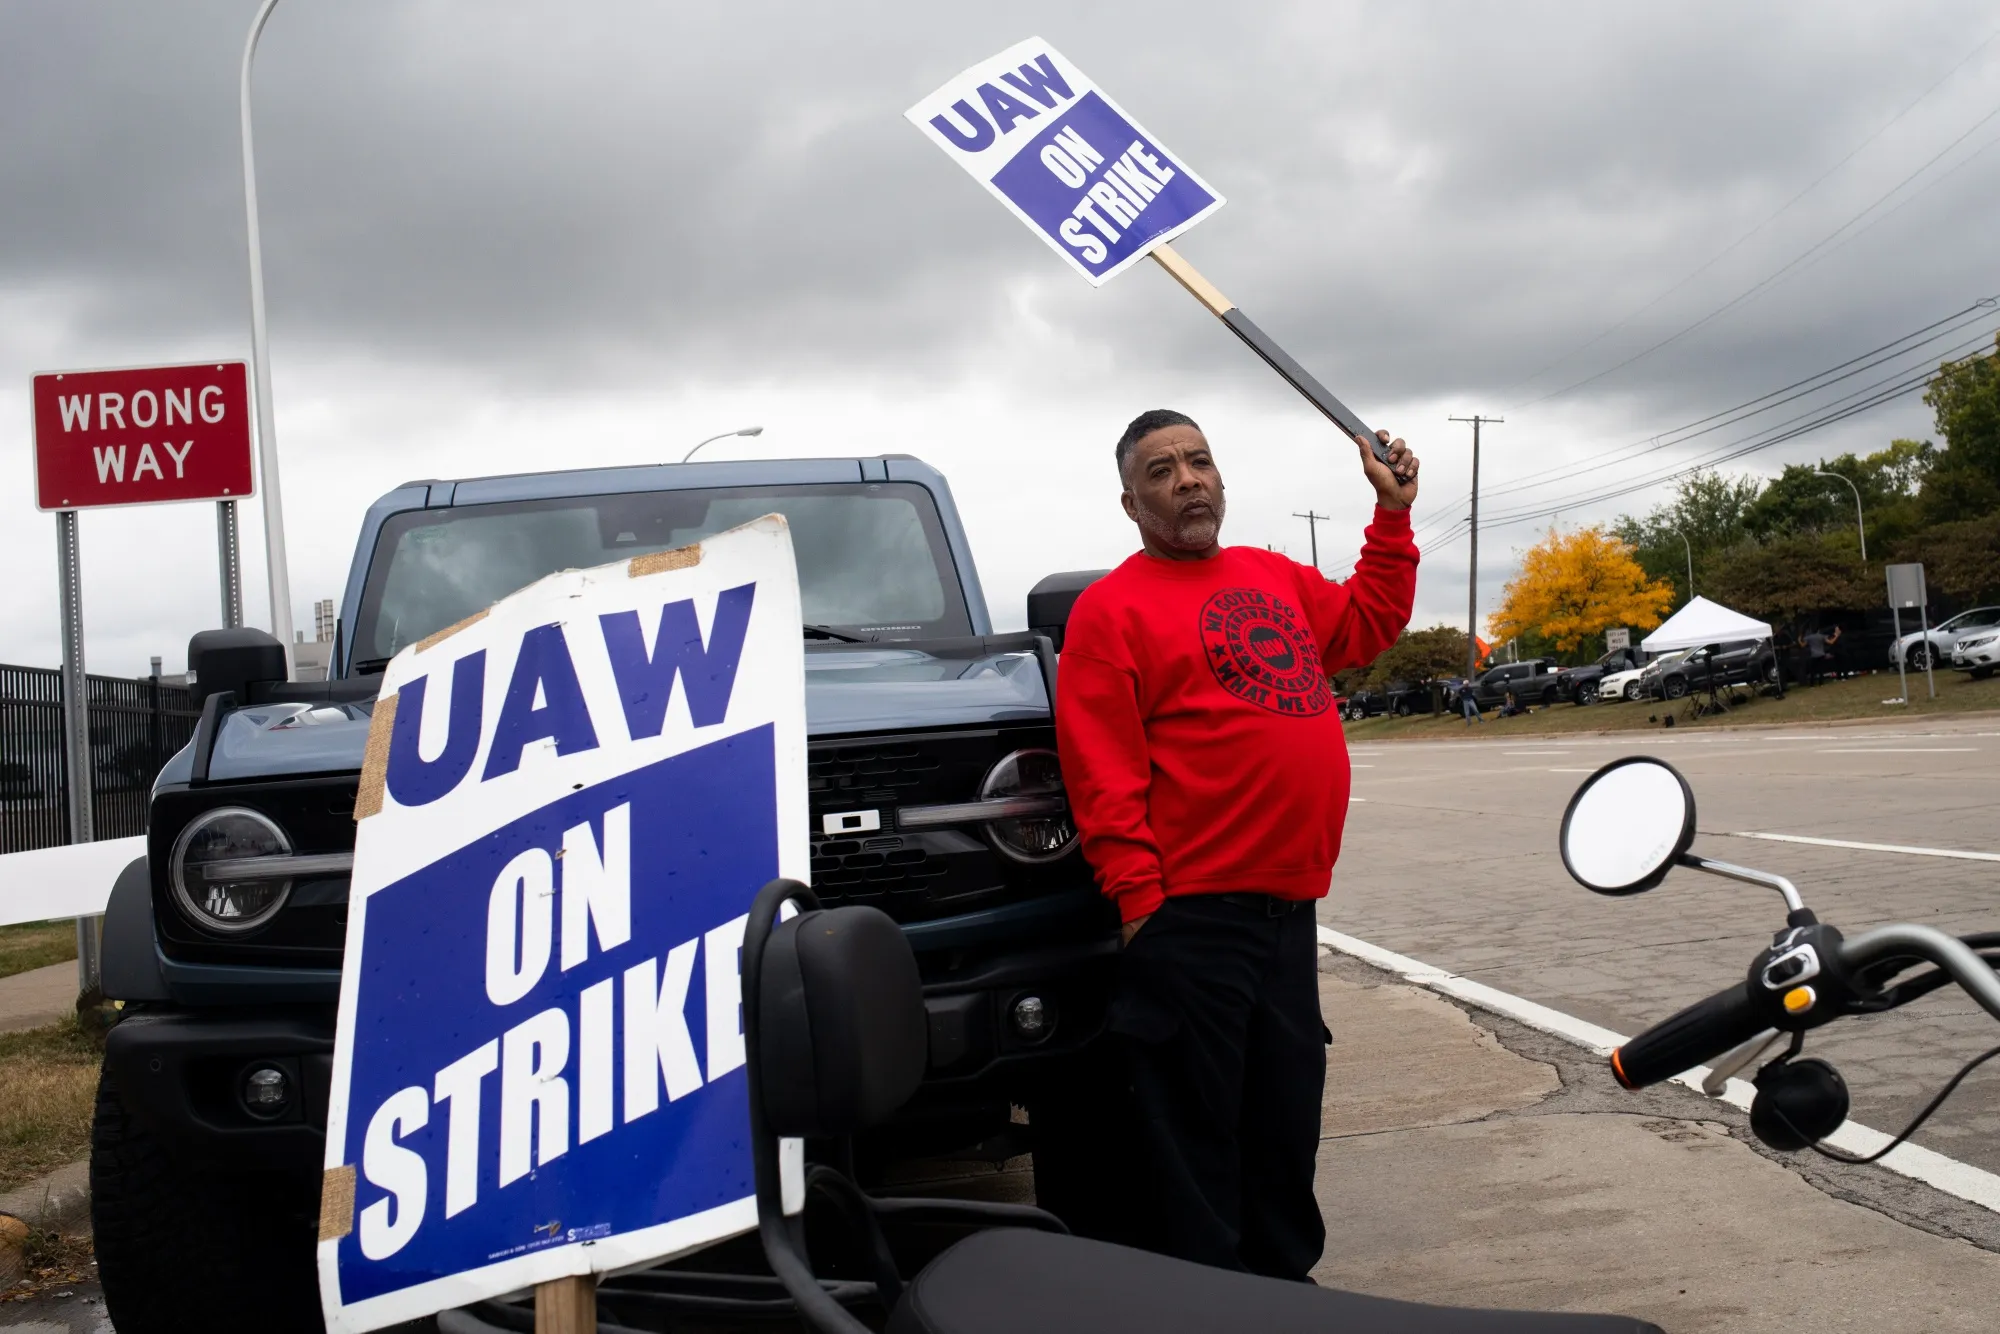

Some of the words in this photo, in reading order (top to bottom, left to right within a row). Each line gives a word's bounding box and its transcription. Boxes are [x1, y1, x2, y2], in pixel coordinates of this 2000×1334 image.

[929, 53, 1076, 154] UAW
[1039, 124, 1106, 190] ON
[1059, 139, 1176, 265] STRIKE
[58, 385, 225, 433] WRONG
[93, 440, 194, 484] WAY
[1205, 611, 1224, 633] WE
[1214, 591, 1268, 611] GOTTA
[1252, 637, 1289, 659] UAW
[386, 581, 757, 807] UAW
[1217, 661, 1271, 705] WHAT
[1276, 693, 1305, 713] WE
[485, 801, 632, 1007] ON
[359, 914, 747, 1262] STRIKE
